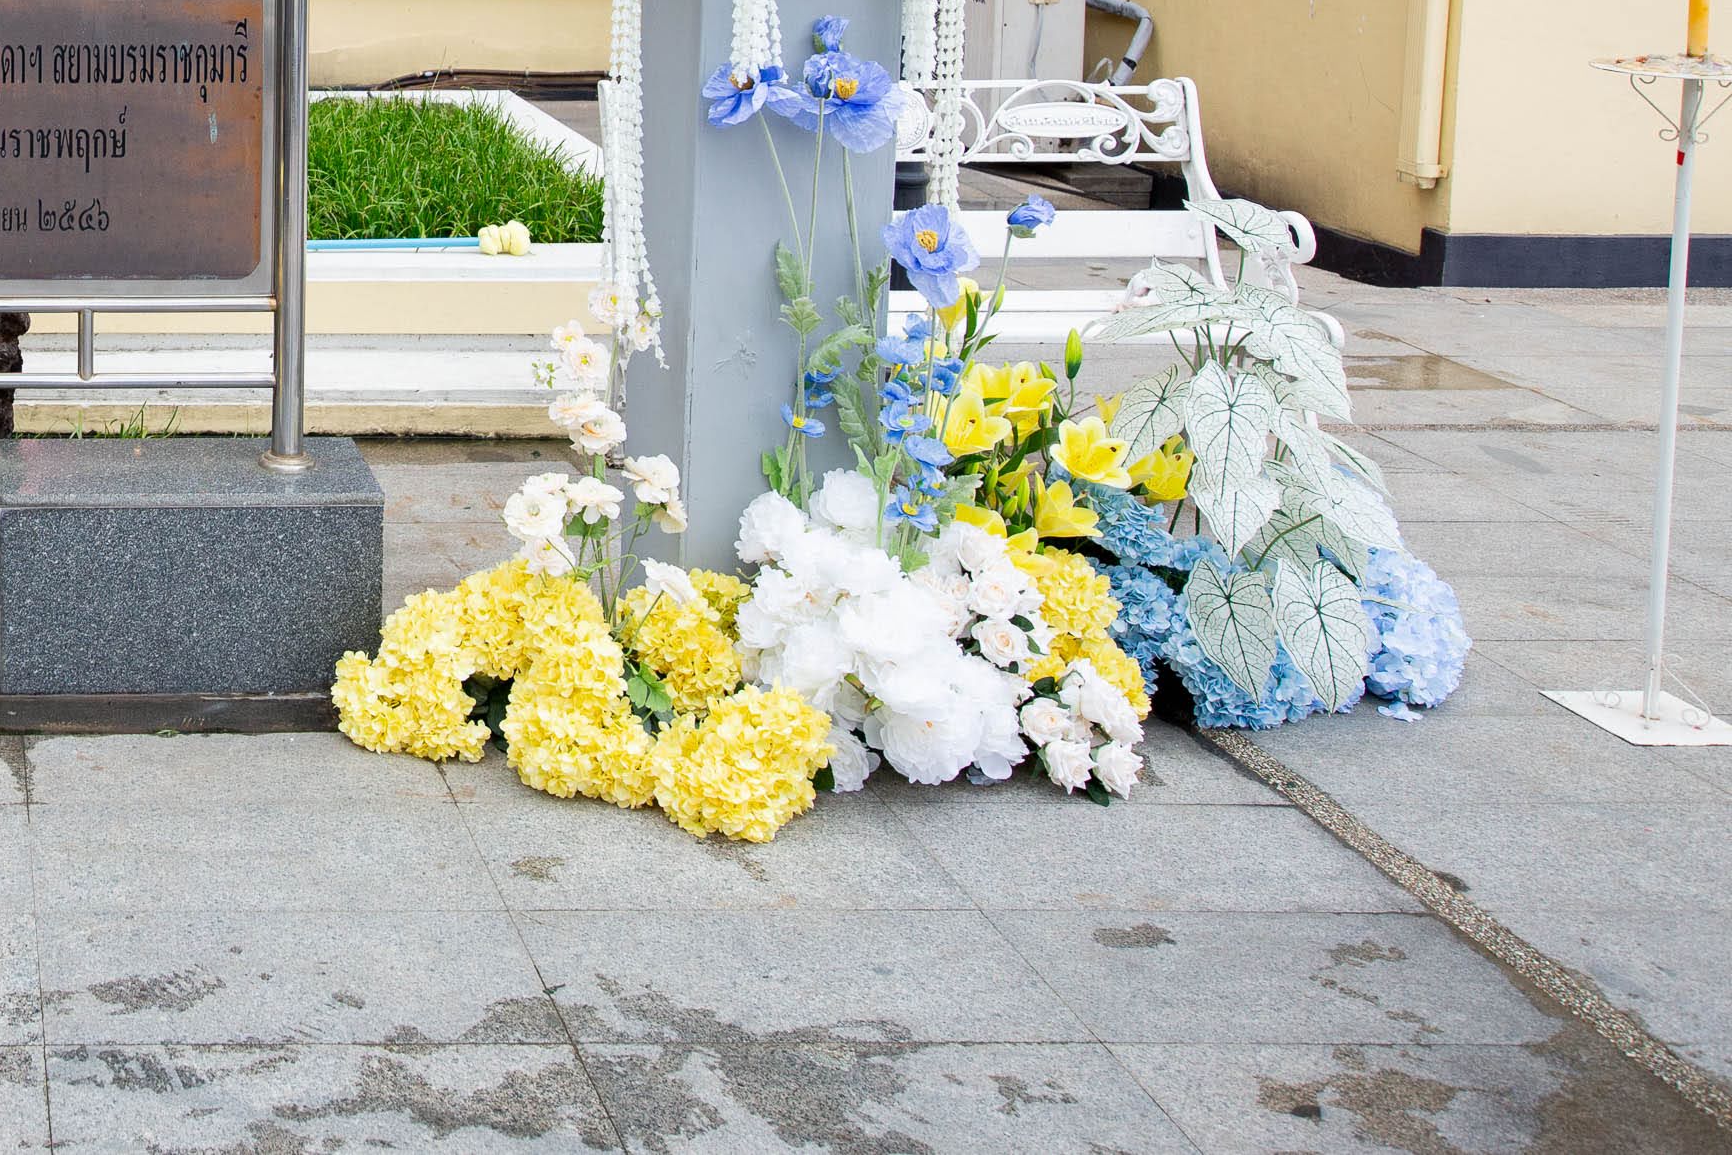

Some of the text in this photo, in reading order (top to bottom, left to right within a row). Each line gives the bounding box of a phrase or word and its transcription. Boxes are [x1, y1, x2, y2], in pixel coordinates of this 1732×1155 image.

[52, 18, 249, 104] สยามบรมราชกุมารี
[37, 198, 110, 232] ๒๕๔๖
